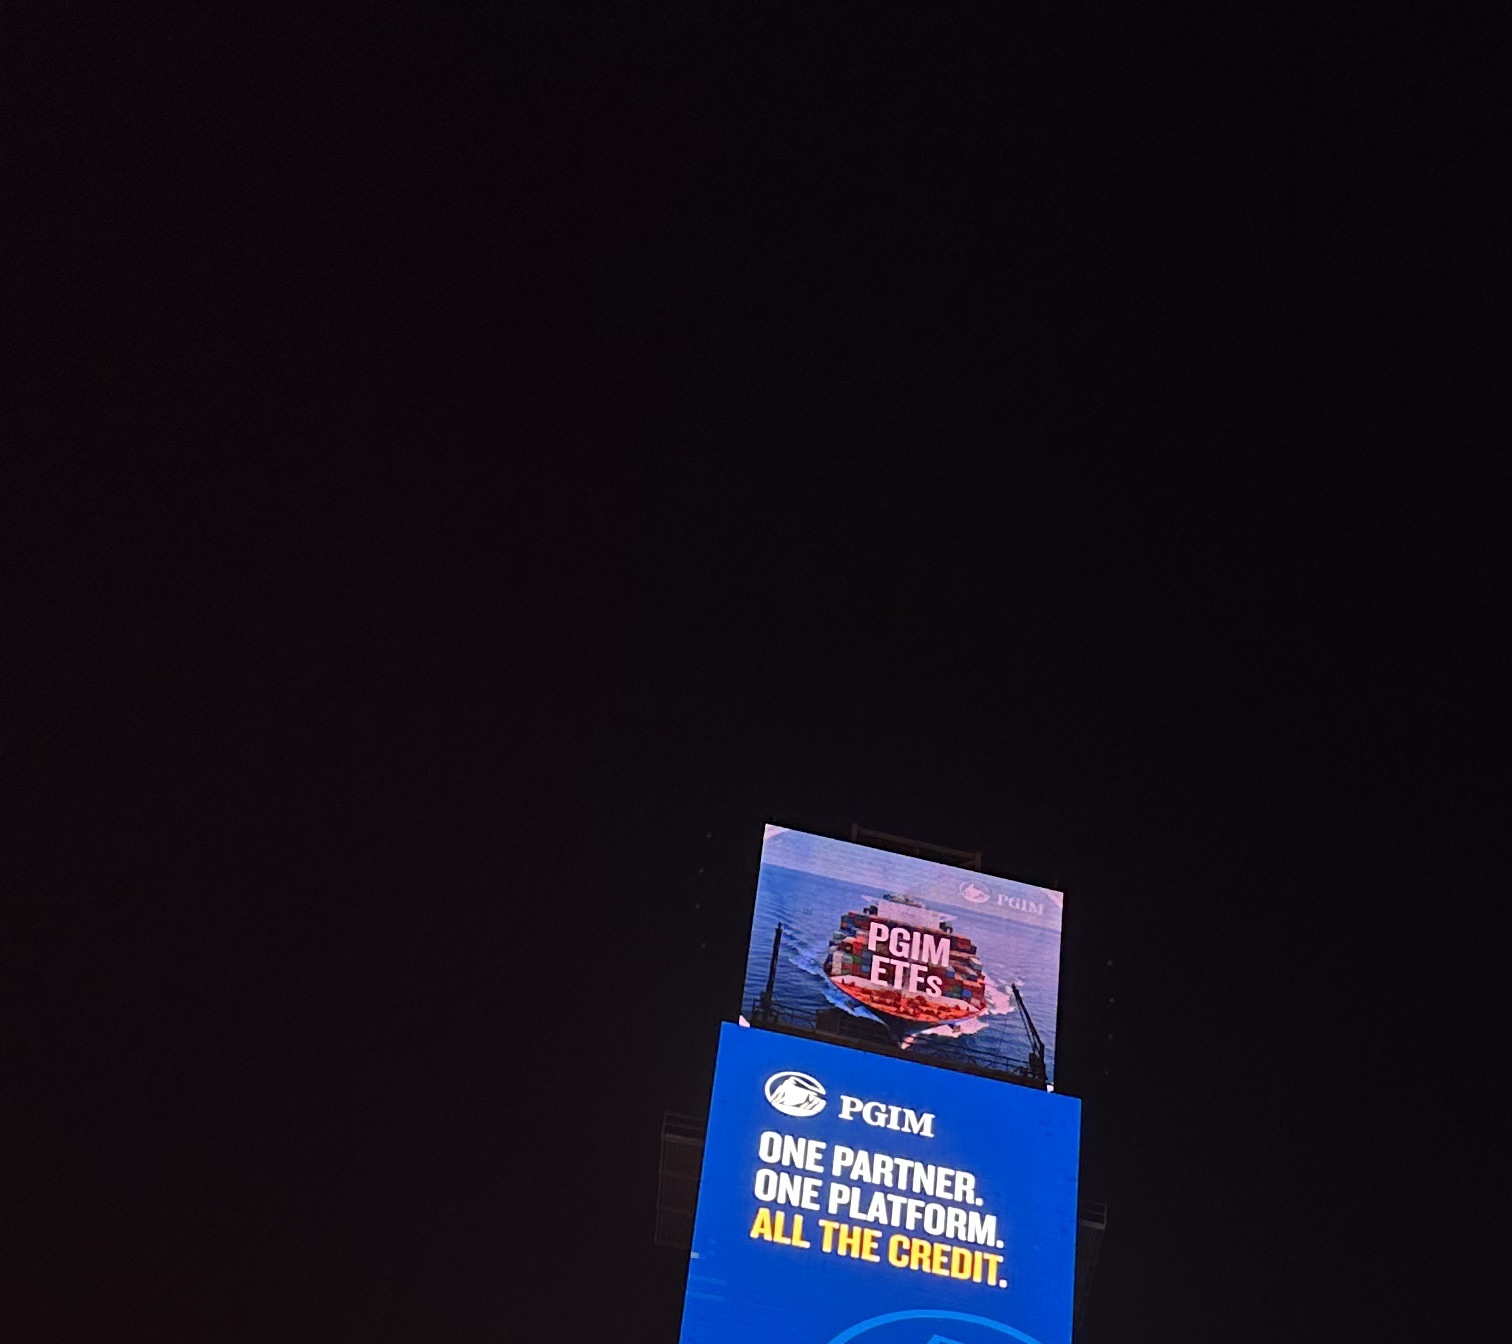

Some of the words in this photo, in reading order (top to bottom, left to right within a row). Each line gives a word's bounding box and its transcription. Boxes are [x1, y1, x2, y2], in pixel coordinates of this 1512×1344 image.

[997, 893, 1045, 916] PGIM
[867, 921, 951, 968] PGIM
[838, 1095, 936, 1138] PGIM
[758, 1131, 826, 1174] ONE
[832, 1144, 985, 1207] PARTNER.
[754, 1169, 821, 1211] ONE
[828, 1183, 1005, 1249] PLATFORM.
[749, 1207, 811, 1249] ALL
[819, 1218, 881, 1263] THE
[888, 1234, 1009, 1289] CREDIT.
